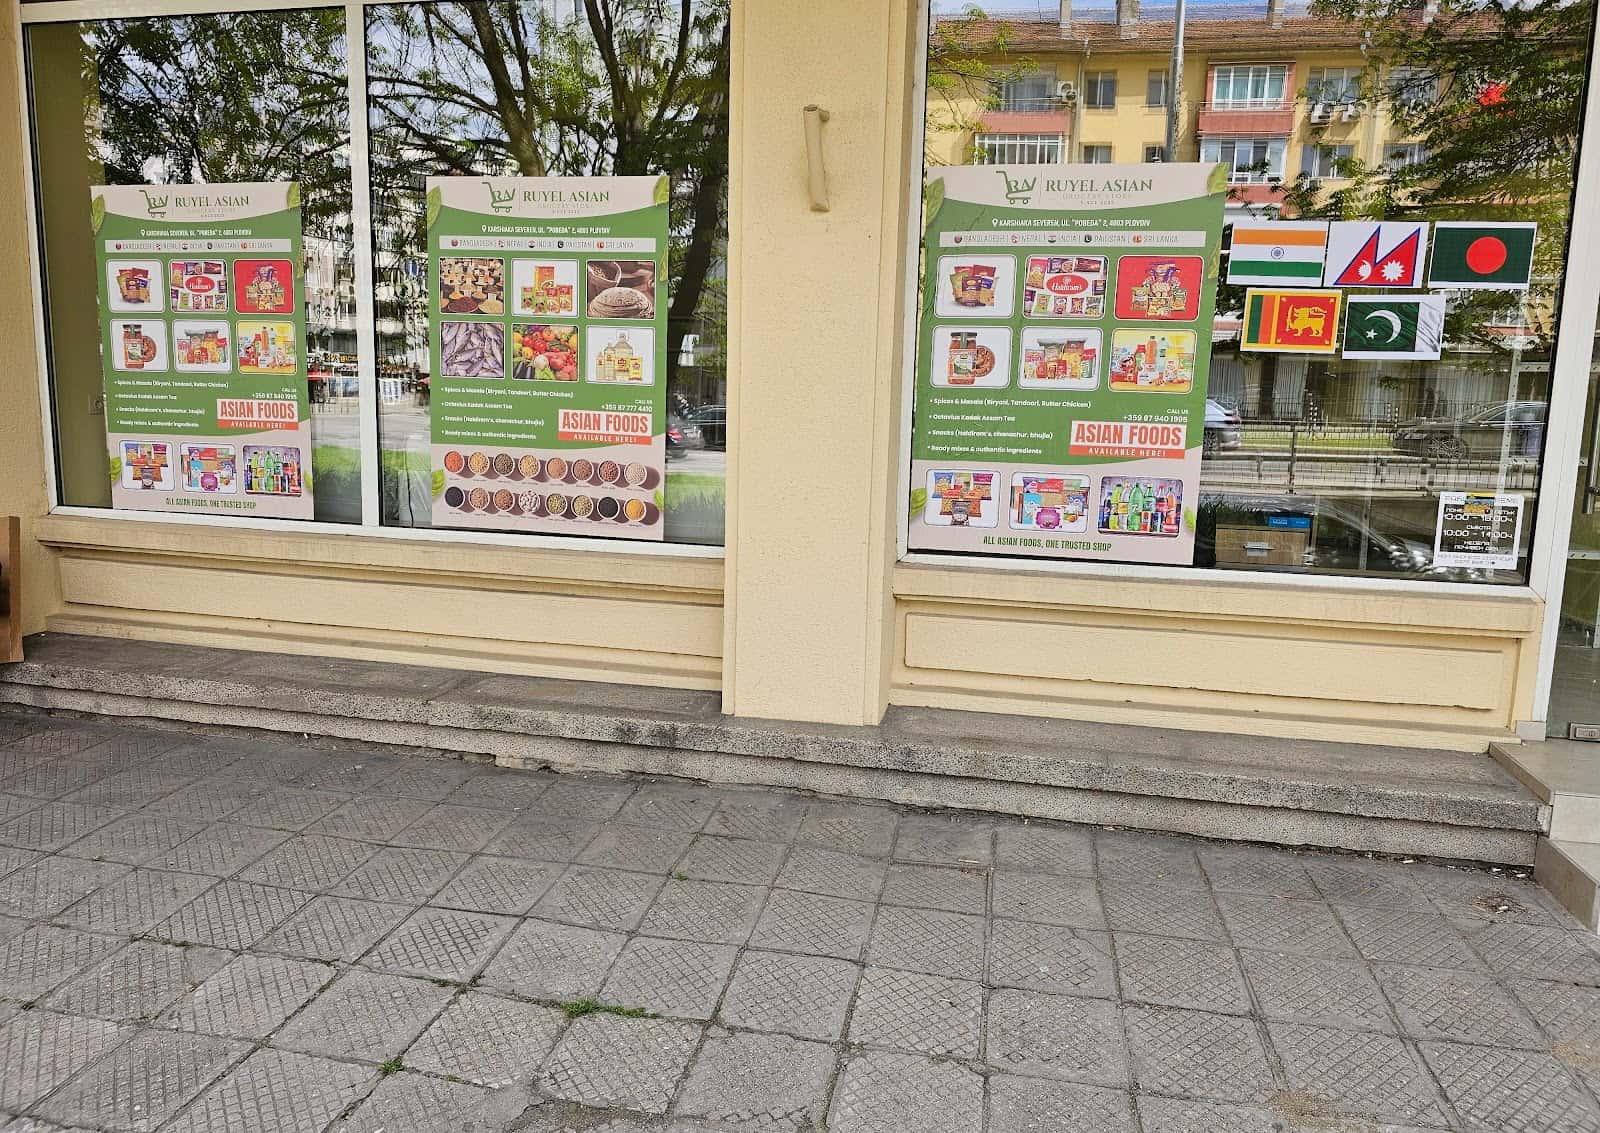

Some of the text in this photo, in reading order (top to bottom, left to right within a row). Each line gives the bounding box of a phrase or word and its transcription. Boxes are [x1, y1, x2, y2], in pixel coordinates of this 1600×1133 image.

[1046, 179, 1153, 192] RUYEL ASIAN
[175, 195, 249, 208] RUYEL ASIAN
[523, 190, 609, 202] RUYEL ASIAN
[220, 401, 254, 418] ASIAN
[257, 402, 295, 419] FOODS
[562, 412, 649, 433] ASIAN FOODS
[1075, 423, 1182, 446] ASIAN FOODS
[1088, 447, 1136, 456] AVAILABLE
[983, 535, 995, 544] ALL
[997, 536, 1018, 546] ASIAN
[1045, 539, 1059, 549] ONE
[1061, 540, 1091, 551] TRUSTED
[1092, 542, 1112, 551] SHOP
